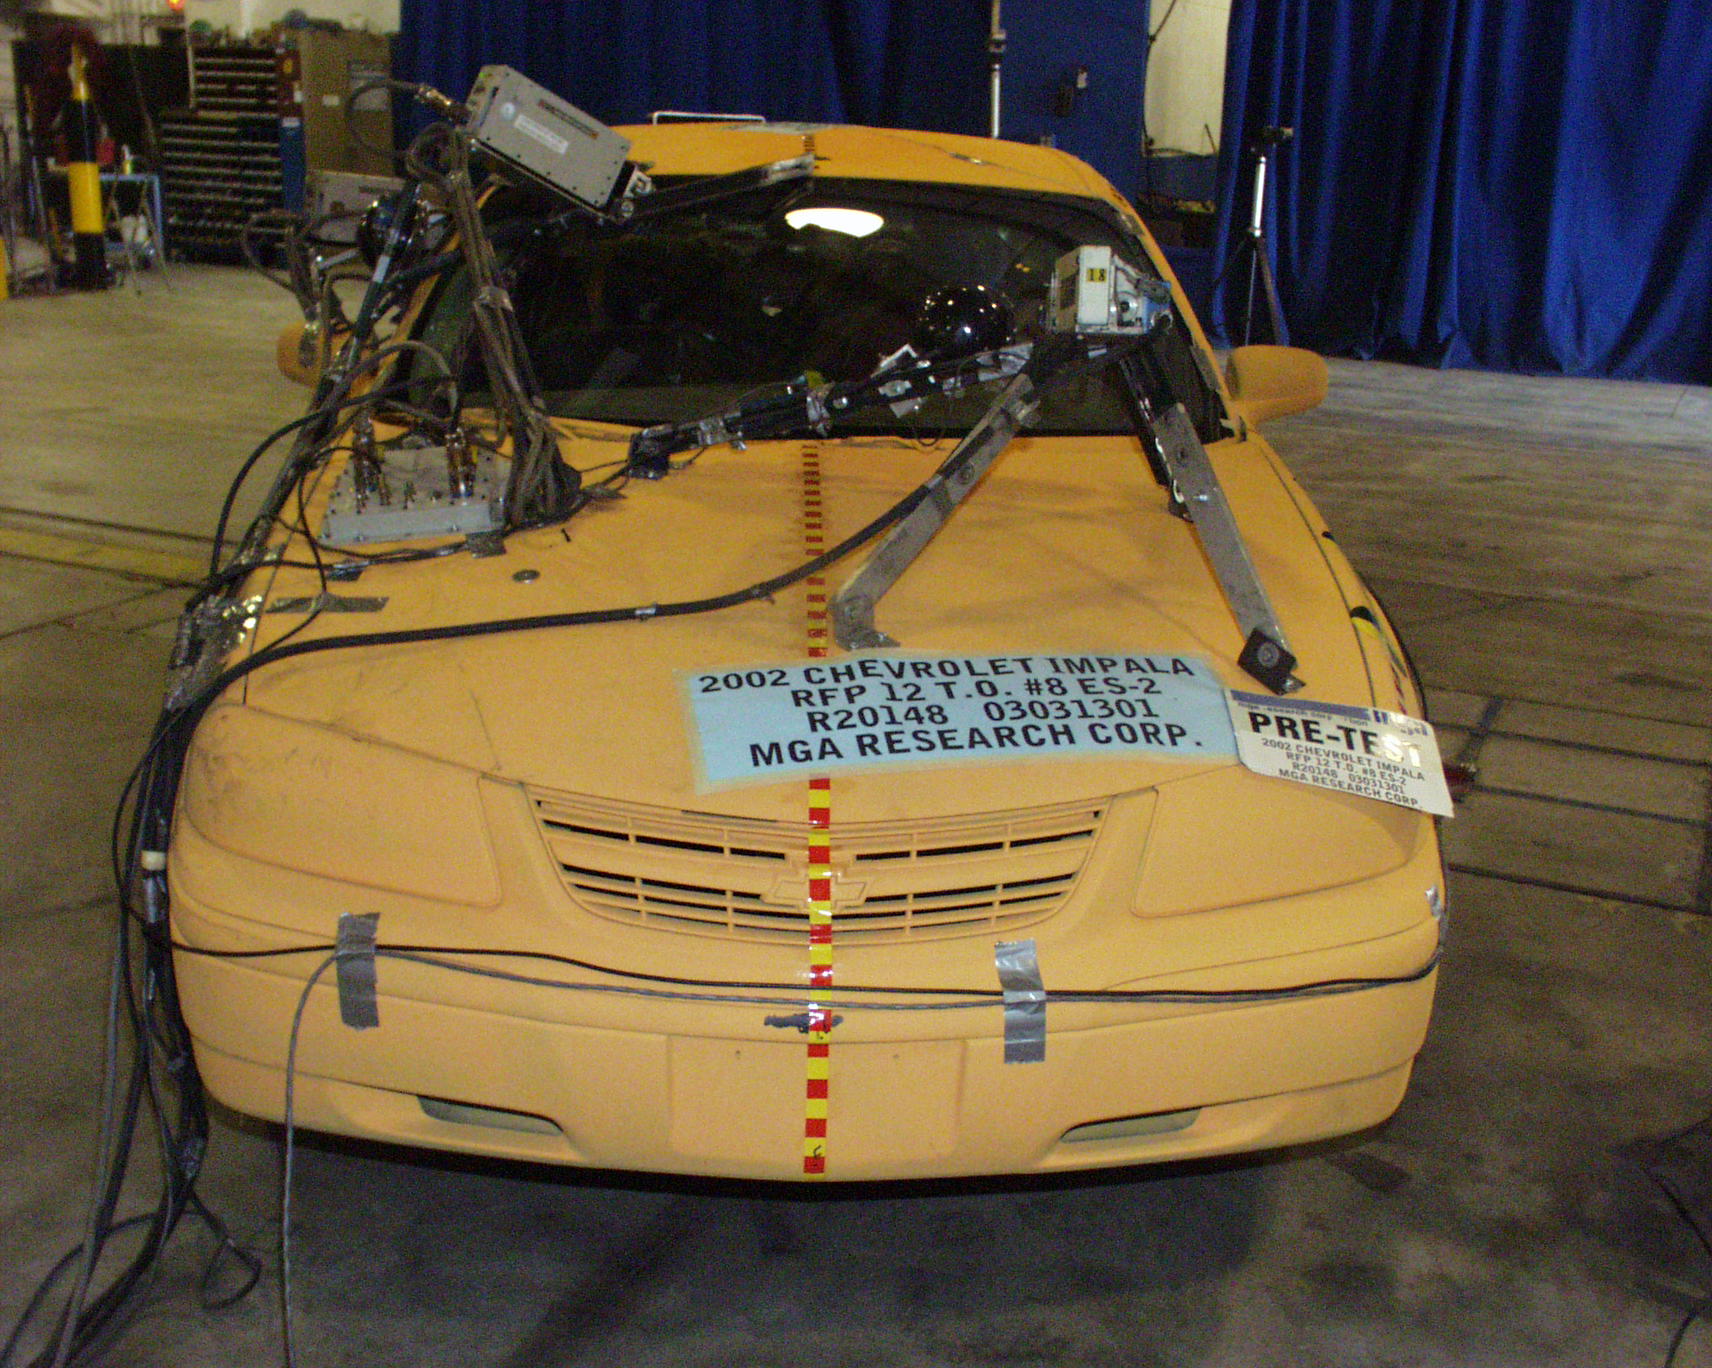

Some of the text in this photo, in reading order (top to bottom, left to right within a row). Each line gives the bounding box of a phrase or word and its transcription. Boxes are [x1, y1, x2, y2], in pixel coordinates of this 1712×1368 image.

[699, 657, 1196, 694] 2002 CHEVROLET IMPALA
[791, 677, 1162, 708] RFP 12 T.O. #8 ES-2
[806, 698, 1160, 733] R20148 03031301
[749, 722, 1203, 768] MGA RESEARCH CORP.
[1248, 711, 1423, 768] PRE-TEST
[1261, 738, 1425, 781] 2002 CHEVROLET IMPALA
[1286, 751, 1311, 763] RFP
[1316, 758, 1330, 768] 12
[1380, 770, 1407, 786] ES-2
[1278, 768, 1309, 782] MGA
[1312, 775, 1382, 798] RESEARCH
[1292, 761, 1405, 794] R20148 03031301
